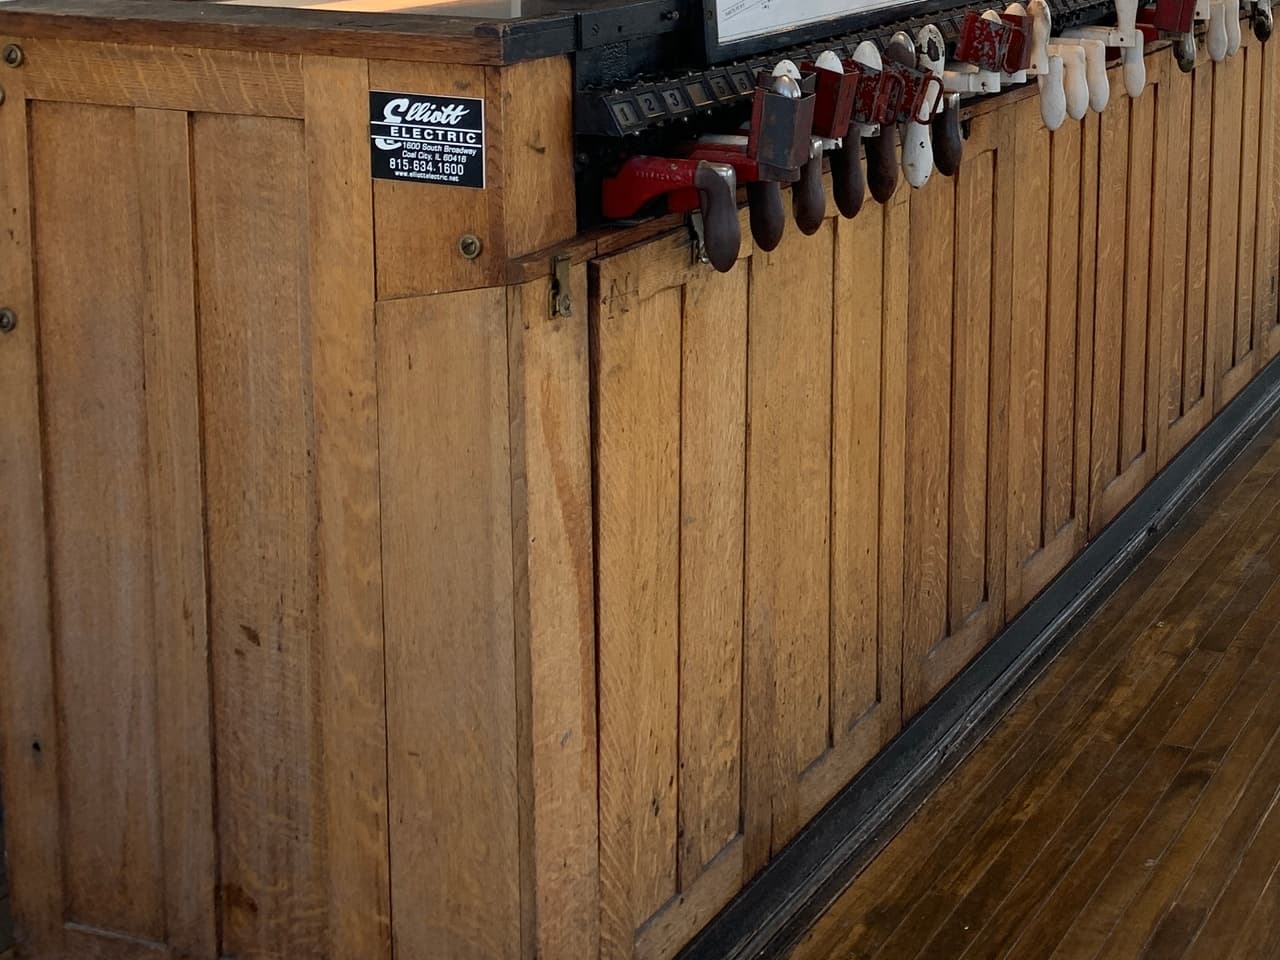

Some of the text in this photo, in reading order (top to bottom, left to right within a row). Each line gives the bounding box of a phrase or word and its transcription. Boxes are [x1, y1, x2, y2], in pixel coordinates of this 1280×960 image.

[620, 108, 629, 121] 1
[644, 98, 654, 112] 2
[669, 92, 680, 106] 3
[390, 126, 476, 143] ELECTRIC
[402, 150, 416, 158] Coal
[422, 143, 442, 152] South
[444, 145, 477, 156] Broadway
